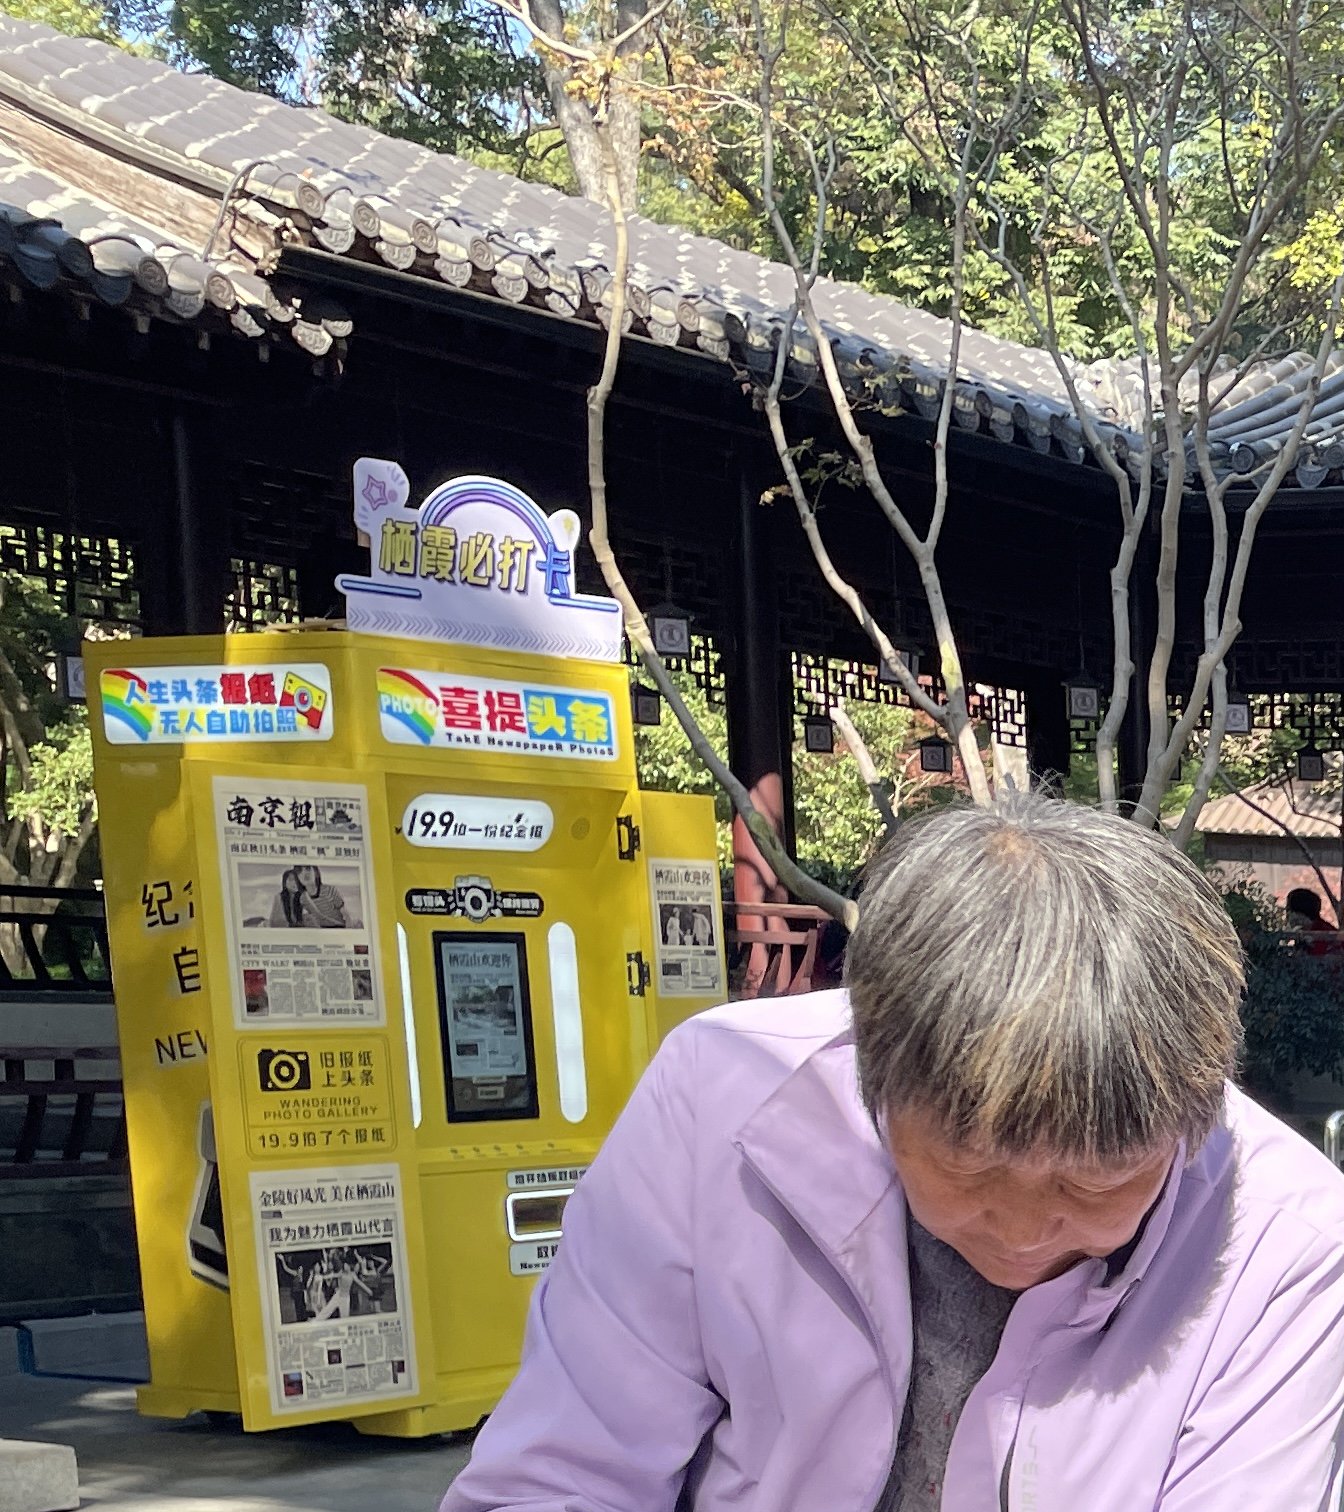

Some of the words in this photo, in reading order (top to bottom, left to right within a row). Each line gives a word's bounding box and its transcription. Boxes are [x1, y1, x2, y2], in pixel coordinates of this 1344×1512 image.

[378, 518, 571, 599] 栖霞必打卡
[124, 671, 278, 706] 人生头条报纸
[159, 707, 298, 735] 无人自助拍照
[438, 686, 610, 743] 喜提头条
[319, 1050, 374, 1069] 旧报纸
[321, 1069, 375, 1088] 上头条
[263, 1109, 312, 1121] PHOTO
[317, 1105, 378, 1118] GALLERY
[279, 1096, 362, 1110] WANDERING
